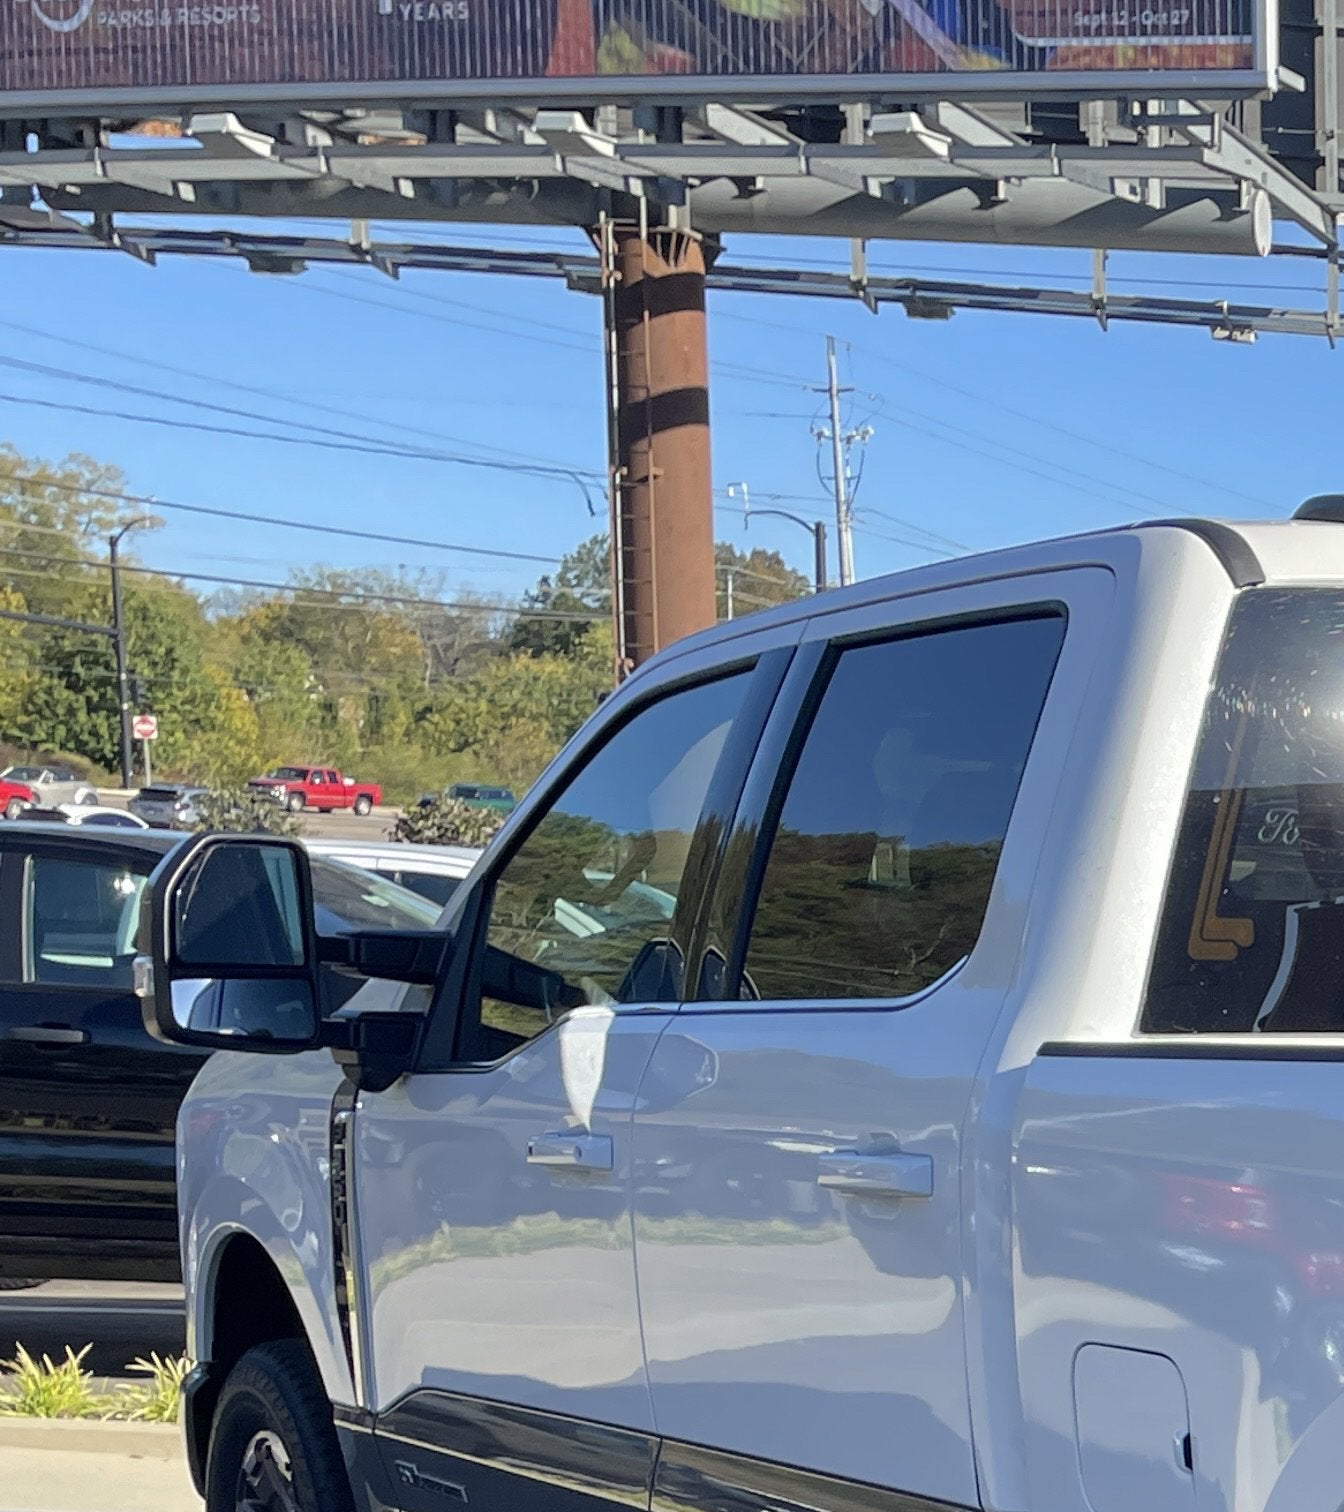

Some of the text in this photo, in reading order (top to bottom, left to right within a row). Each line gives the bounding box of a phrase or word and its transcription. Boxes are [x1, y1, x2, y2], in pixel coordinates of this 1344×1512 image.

[97, 9, 154, 27] PARKS
[177, 5, 262, 26] RESORTS
[399, 2, 469, 21] YEARS
[1074, 11, 1107, 31] Sept
[1141, 11, 1168, 26] Oct
[1171, 10, 1190, 25] 27
